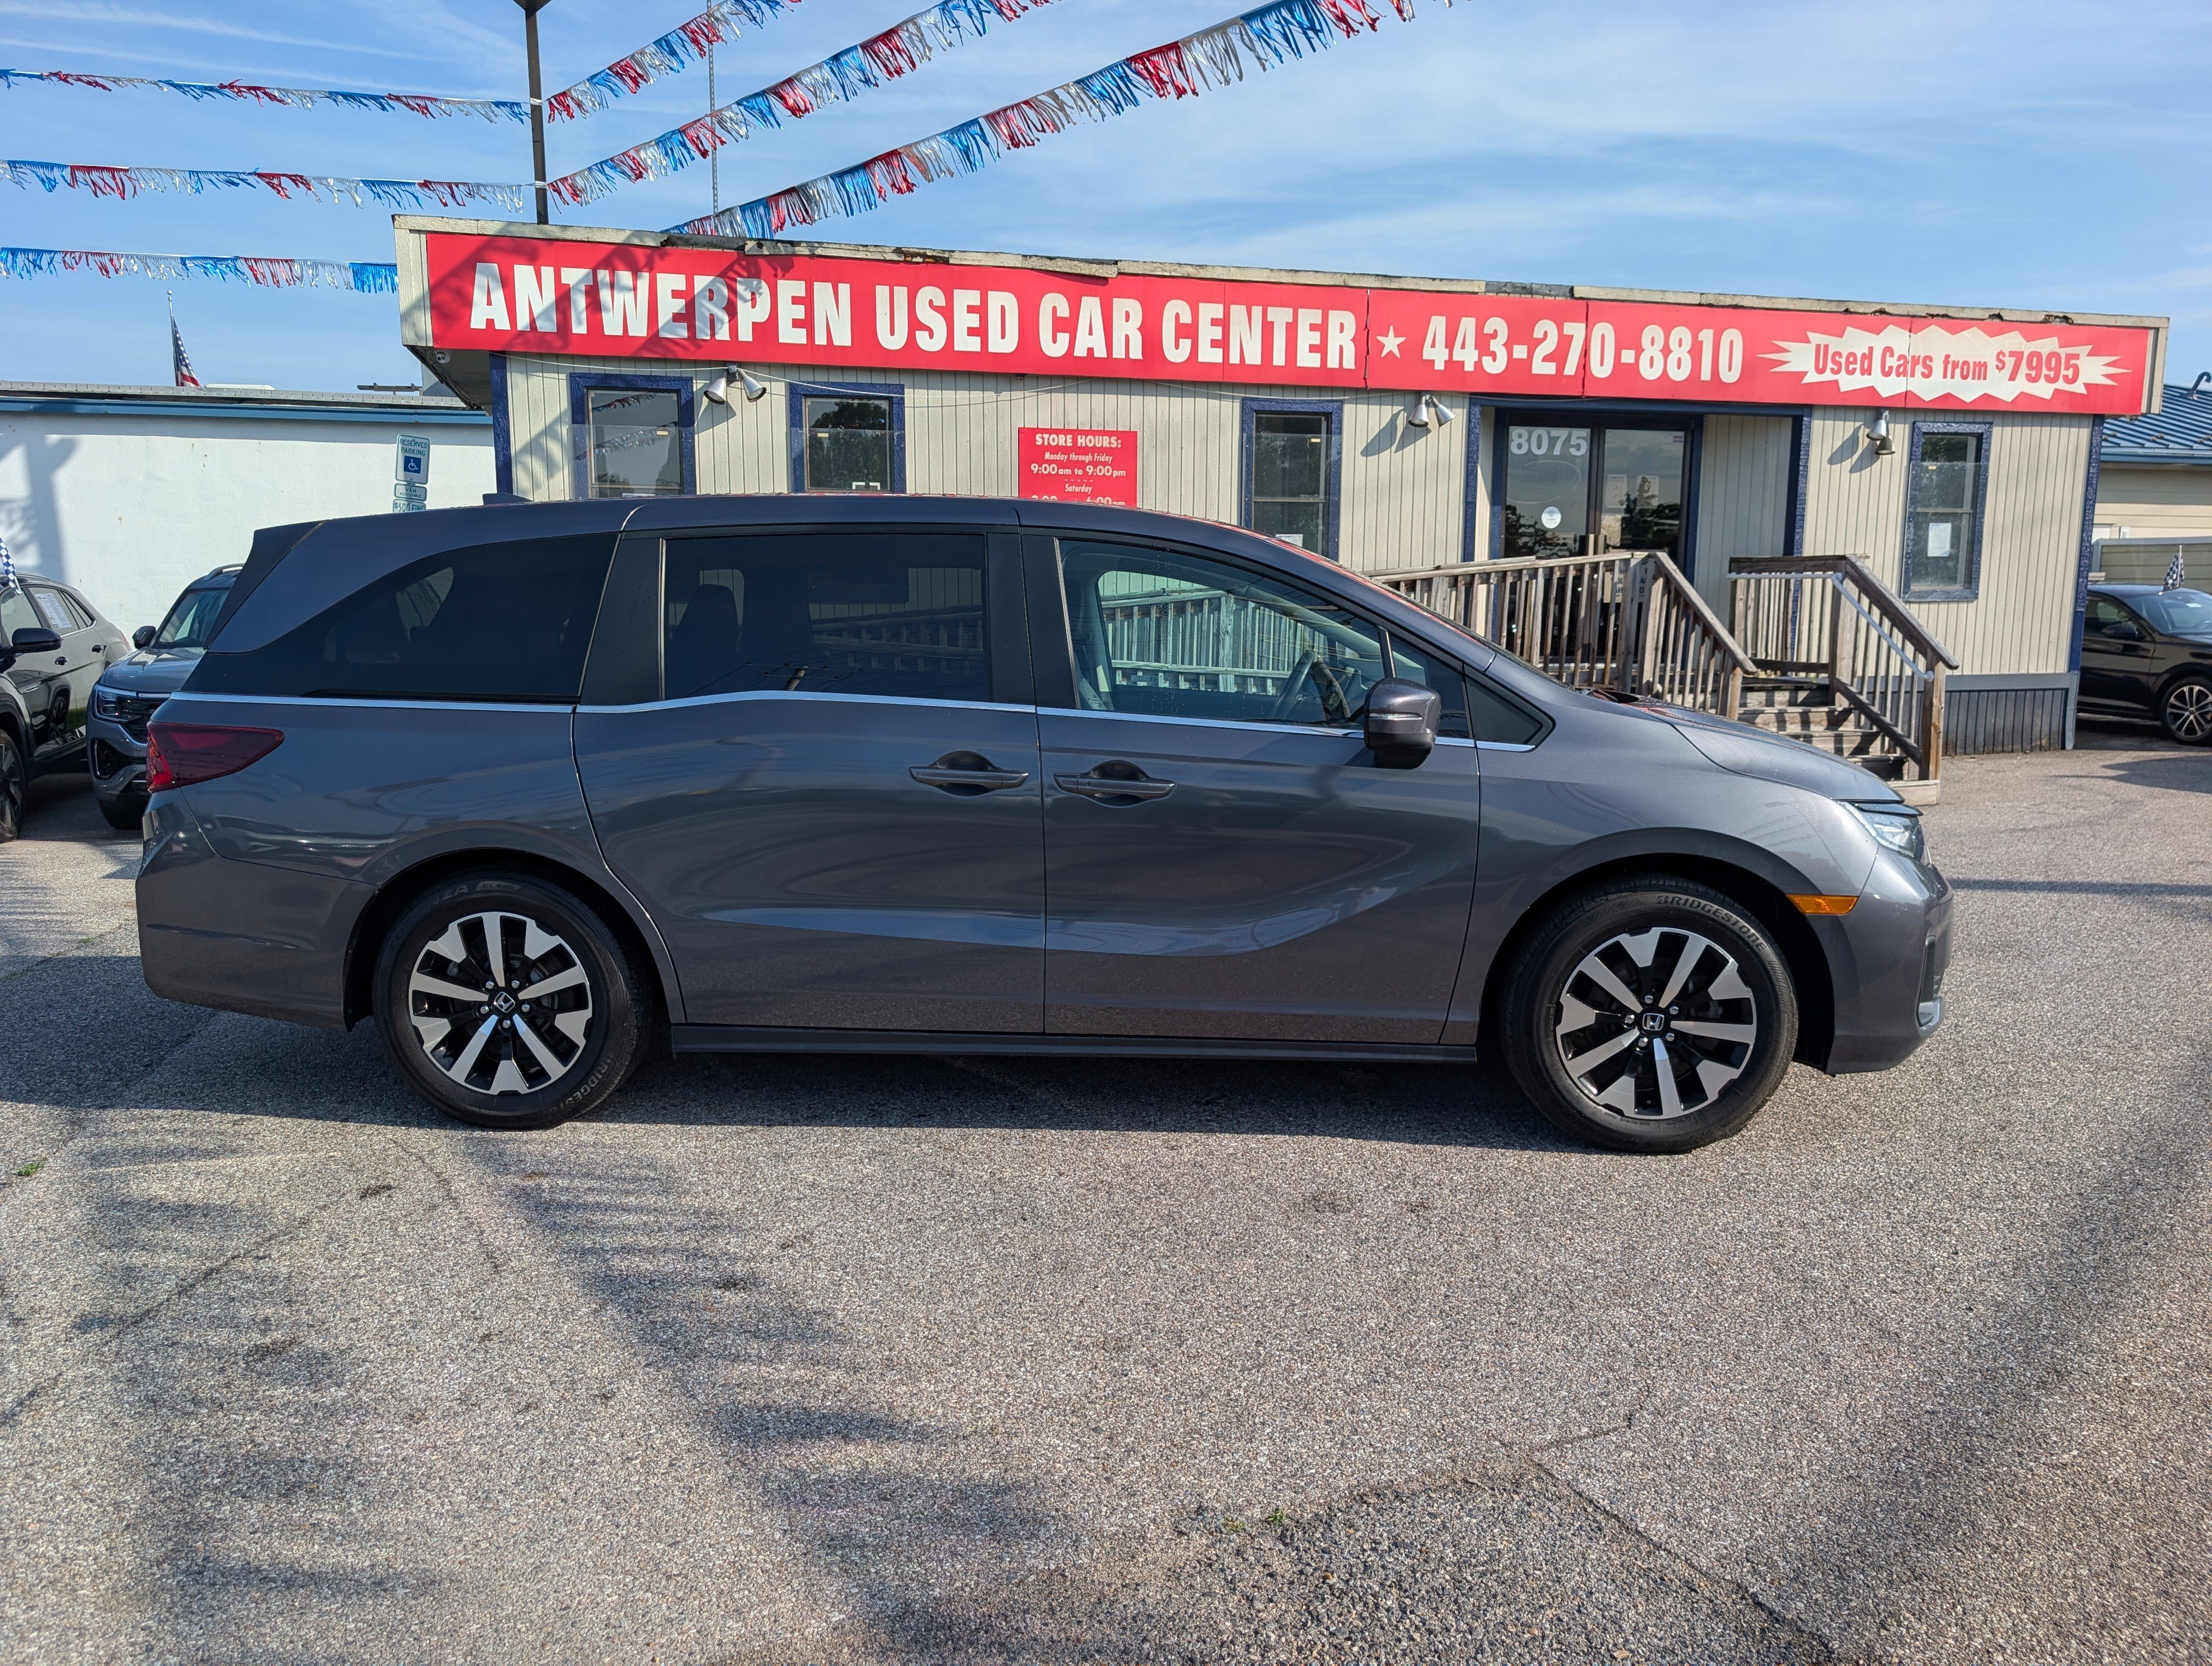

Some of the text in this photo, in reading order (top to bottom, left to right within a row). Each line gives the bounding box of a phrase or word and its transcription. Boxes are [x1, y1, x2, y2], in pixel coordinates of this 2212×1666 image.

[470, 262, 1744, 384] ANTWERPEN USED CAR CENTER 443-270-8810
[1814, 343, 2080, 385] Used Cars from $7995
[400, 438, 428, 449] RESERVED
[1035, 433, 1122, 448] STORE HOURS:
[1510, 428, 1587, 456] 8075
[401, 447, 426, 456] PARKING
[1044, 451, 1113, 464] Monday through Friday
[1064, 483, 1093, 495] Saturday
[394, 502, 410, 512] $500
[1655, 895, 1767, 952] BRIDGESTONE
